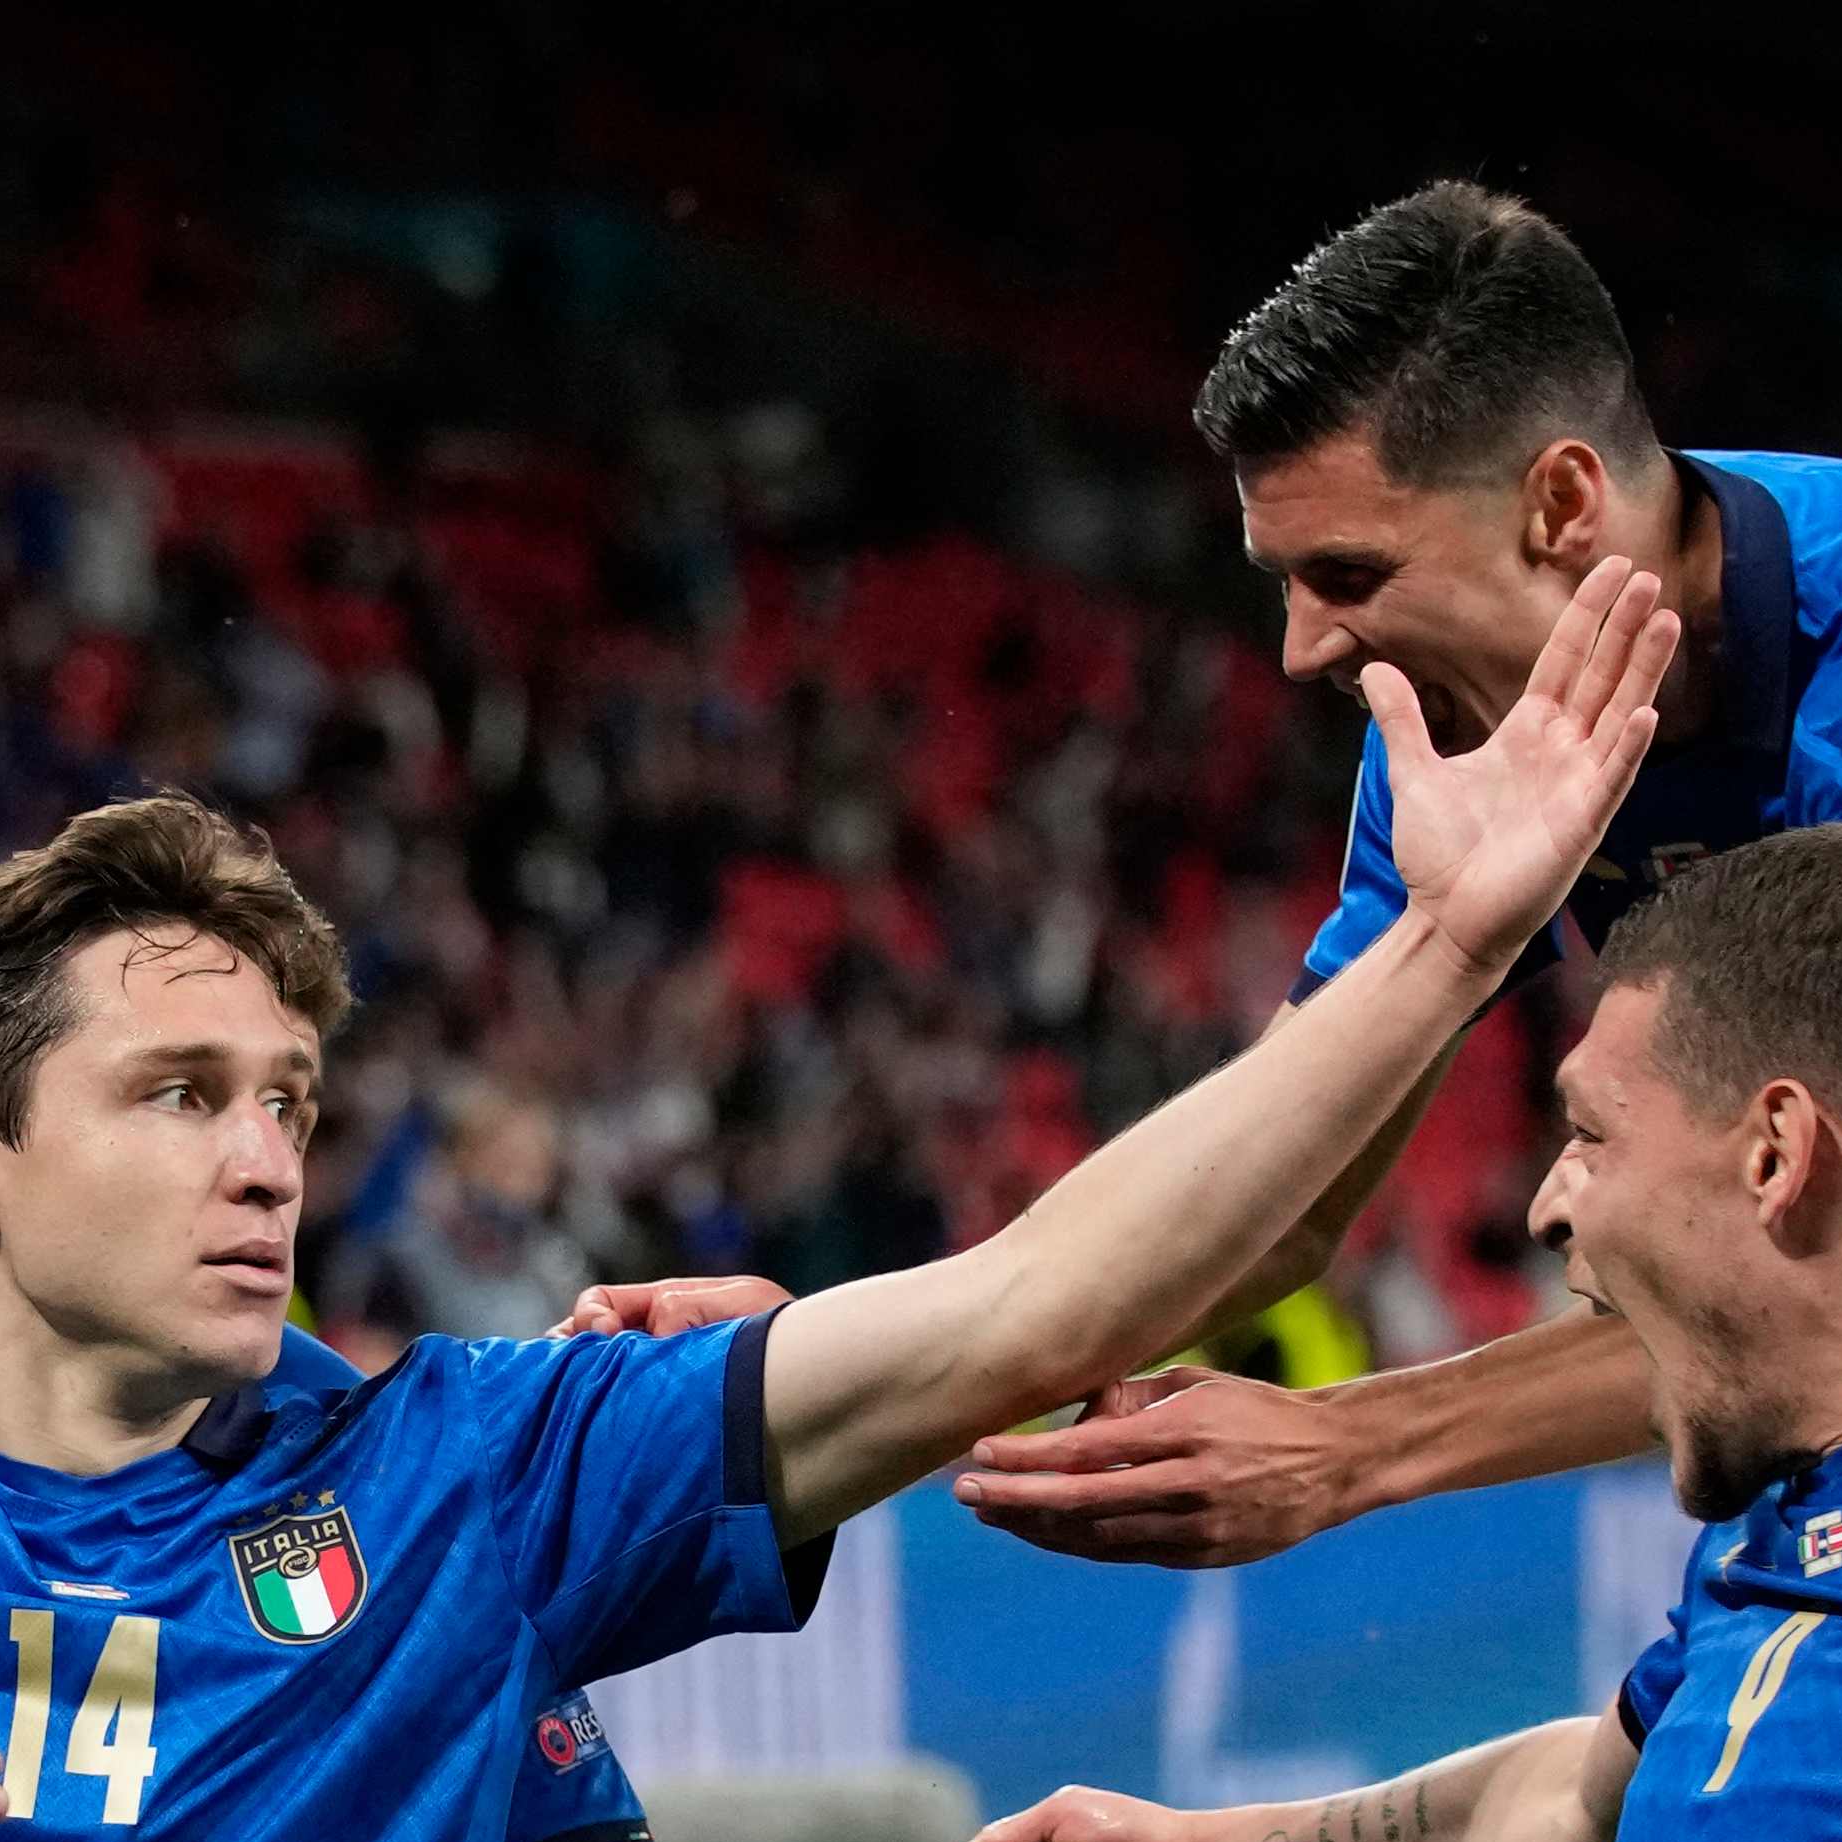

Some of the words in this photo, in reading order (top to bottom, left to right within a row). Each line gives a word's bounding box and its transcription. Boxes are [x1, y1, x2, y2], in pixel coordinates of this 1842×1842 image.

[243, 1520, 341, 1564] ITALIA
[7, 1608, 161, 1826] 14
[1701, 1611, 1829, 1793] 9
